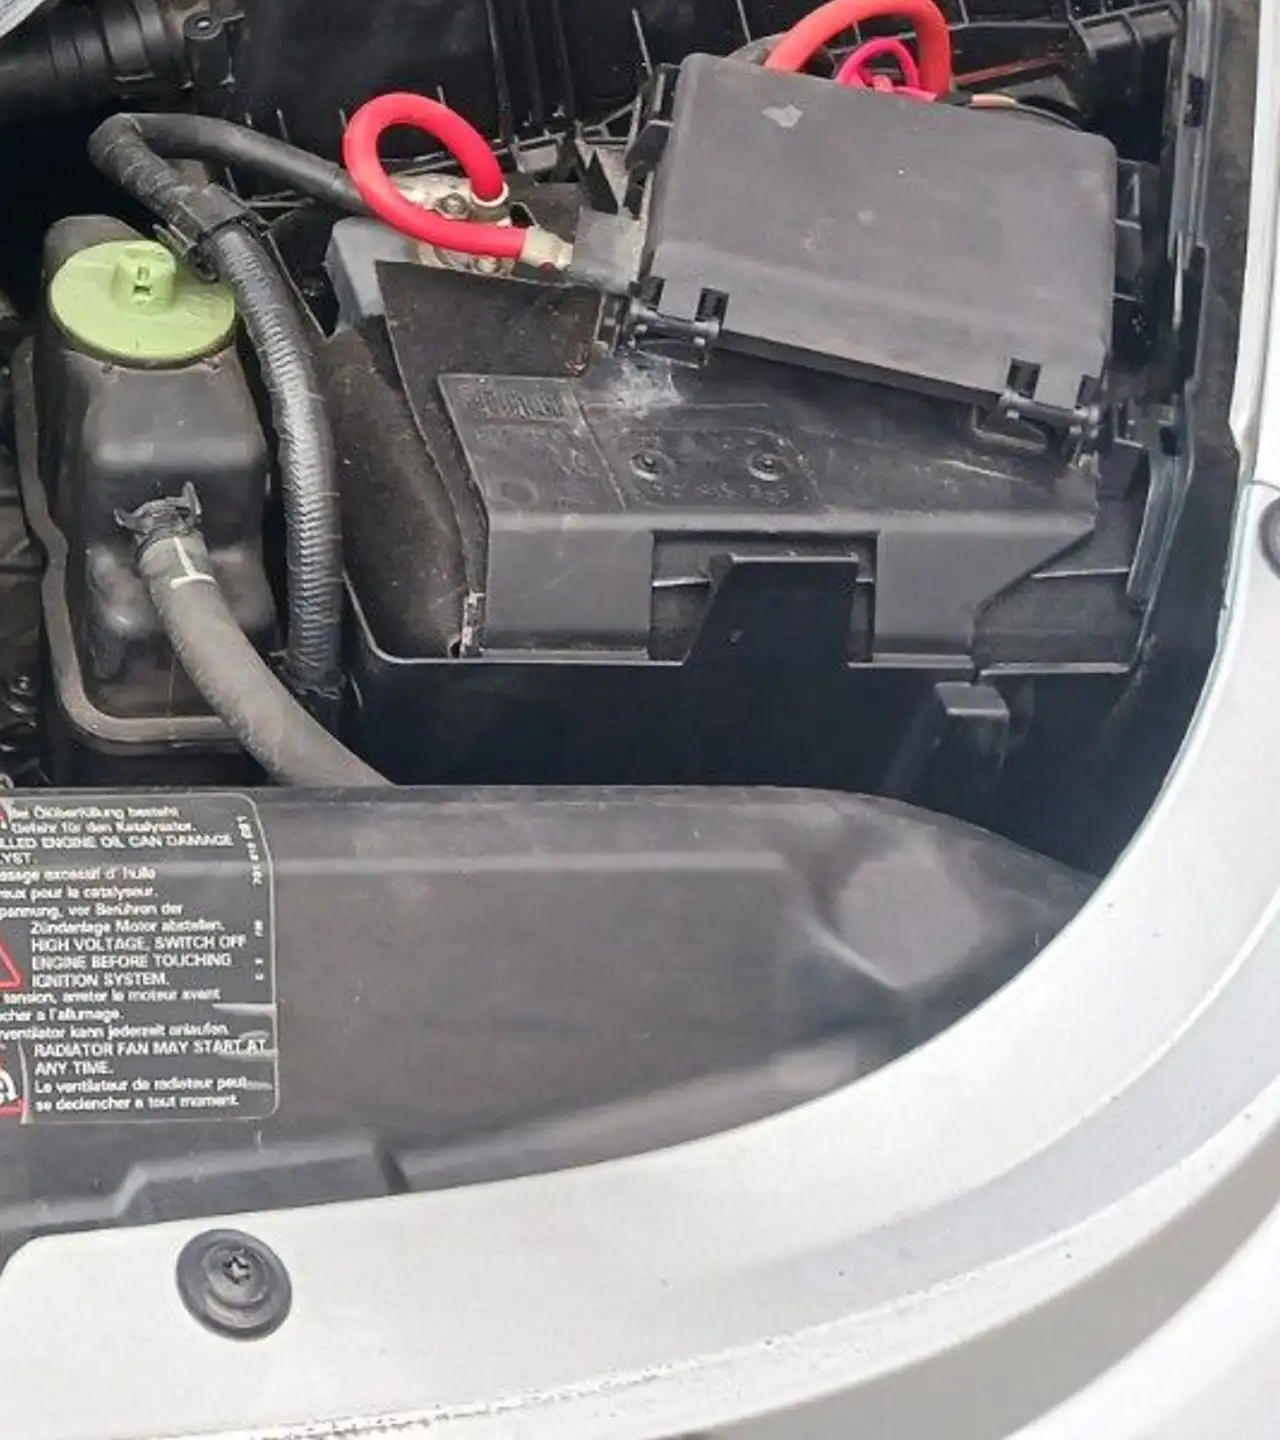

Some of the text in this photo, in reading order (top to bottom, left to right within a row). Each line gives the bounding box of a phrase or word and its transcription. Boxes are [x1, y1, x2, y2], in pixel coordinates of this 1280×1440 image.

[41, 836, 99, 849] ENGINE
[100, 835, 127, 849] OIL
[128, 835, 164, 848] CAN
[165, 834, 235, 847] DAMAGE
[29, 886, 63, 903] pour
[67, 885, 80, 899] le
[161, 901, 184, 916] der
[115, 919, 157, 932] Motor
[31, 938, 70, 952] HIGH
[154, 935, 216, 950] SWITCH
[219, 934, 247, 948] OFF
[31, 952, 233, 970] ENGINE BEFORE TOUCHING
[31, 971, 171, 988] IGNITION SYSTEM.
[112, 988, 125, 1002] le
[34, 1039, 267, 1058] RADIATOR FAN MAY START AT
[35, 1061, 68, 1076] ANY
[34, 1079, 52, 1093] Le
[132, 1077, 151, 1091] de
